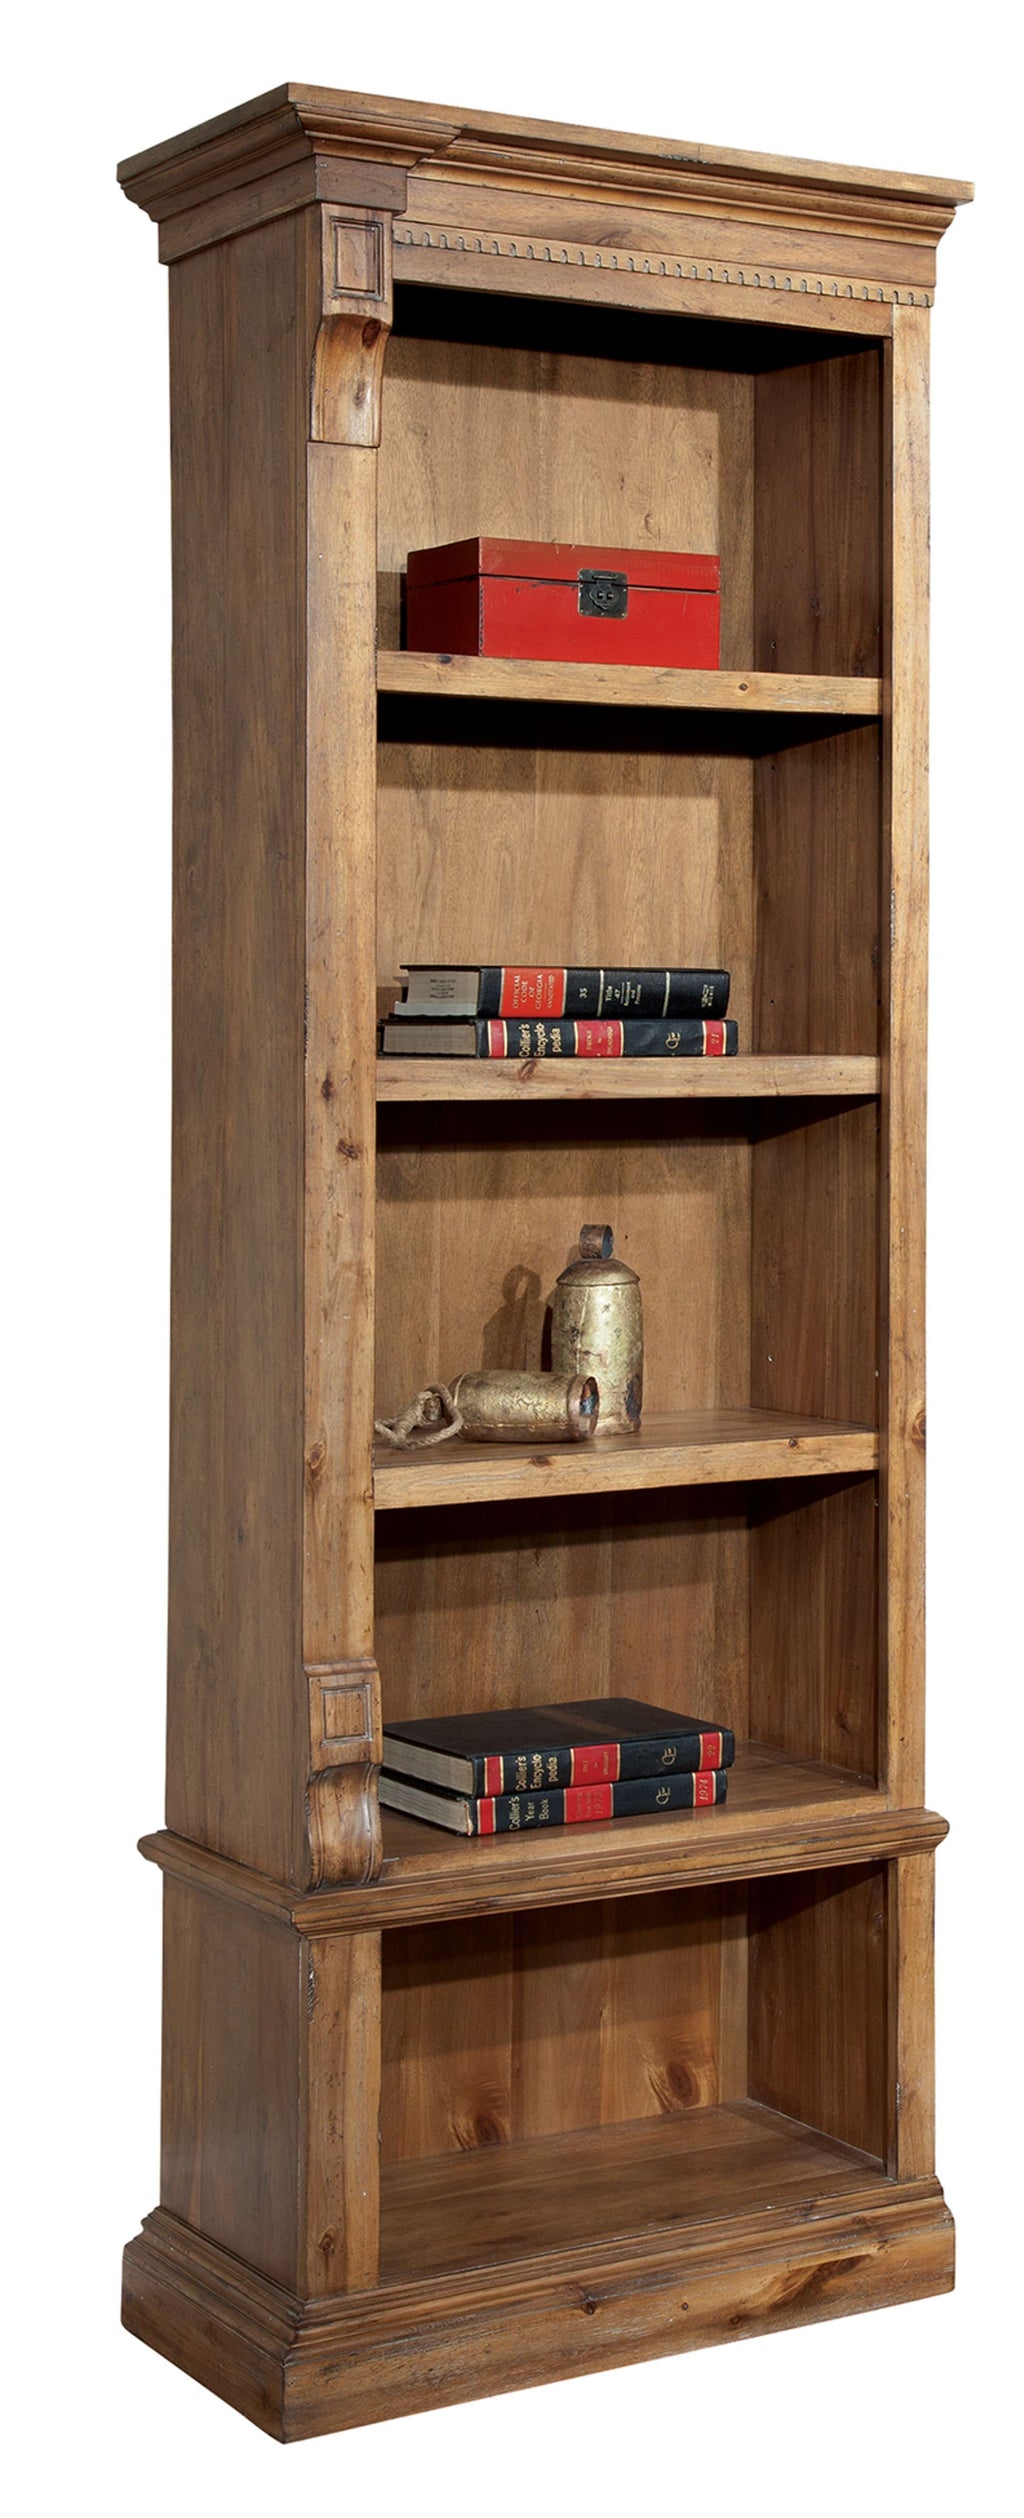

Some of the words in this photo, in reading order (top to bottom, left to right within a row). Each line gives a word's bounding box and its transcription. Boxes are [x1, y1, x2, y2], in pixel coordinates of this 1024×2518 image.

[512, 975, 521, 1009] OFFICIAL
[520, 980, 528, 1003] CODE
[528, 986, 535, 998] OF
[535, 974, 544, 1010] GEORGIA
[546, 974, 555, 1009] ANNOTATED
[579, 987, 588, 999] 35
[518, 1024, 531, 1057] Collier's
[550, 1027, 562, 1053] pedia
[515, 1755, 527, 1791] Collier's
[546, 1757, 559, 1783] pedia
[698, 1778, 708, 1801] 1974
[508, 1796, 520, 1831] Collier's
[525, 1801, 536, 1822] Year
[538, 1798, 550, 1821] Book
[593, 1792, 603, 1815] 1973
